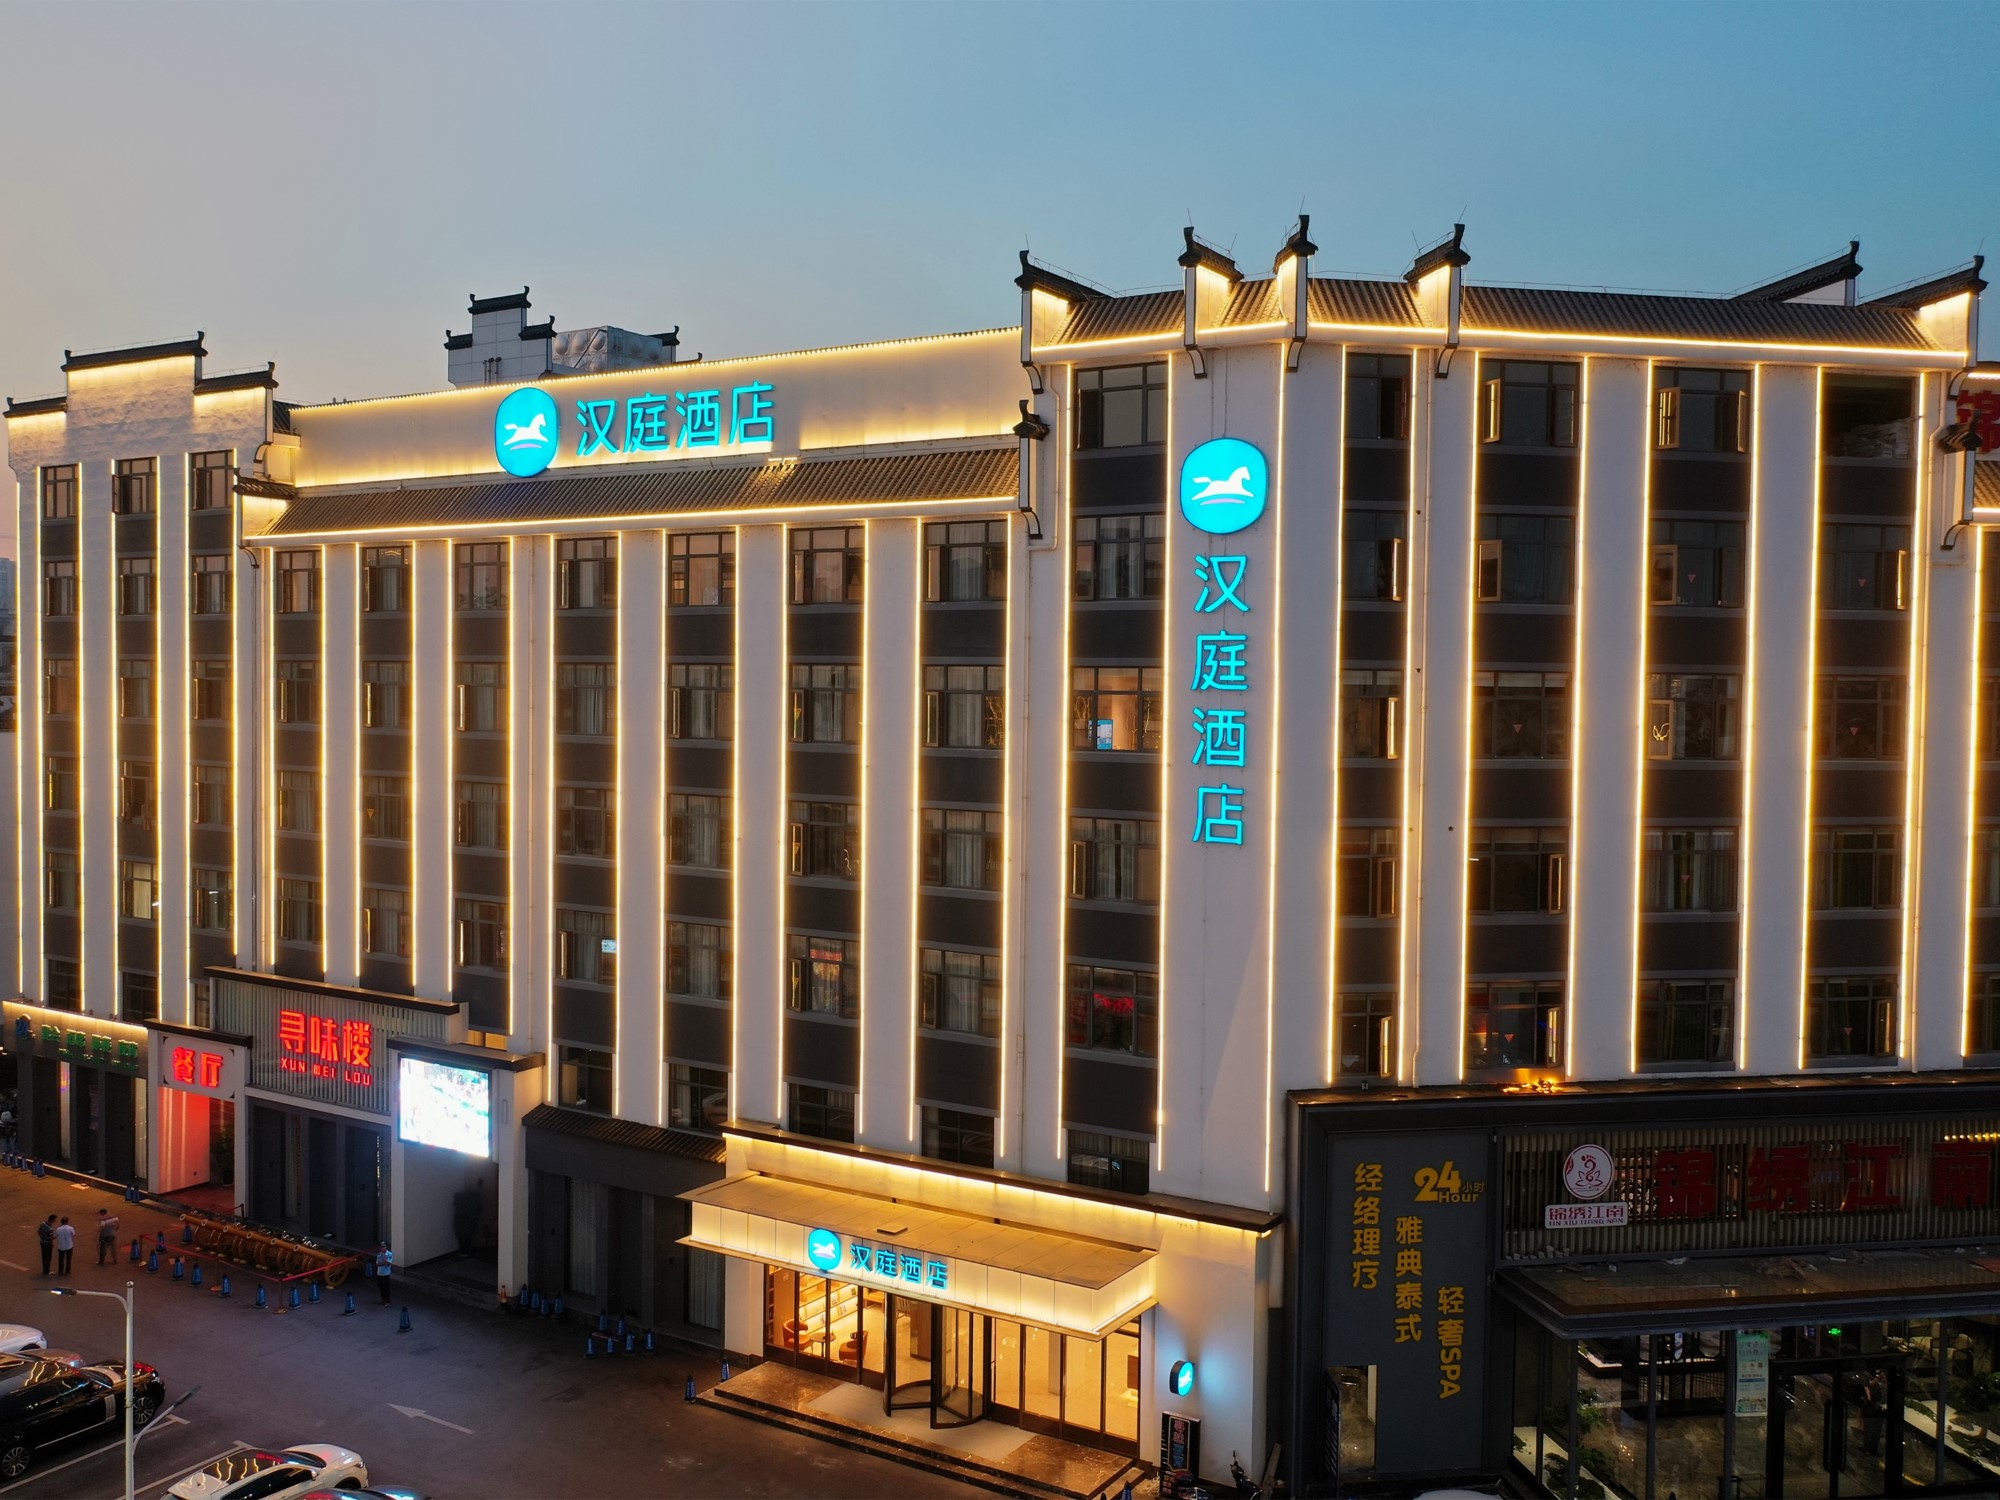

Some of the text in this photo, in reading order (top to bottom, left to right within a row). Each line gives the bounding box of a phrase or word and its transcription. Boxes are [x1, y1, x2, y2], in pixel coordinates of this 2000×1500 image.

[576, 381, 774, 457] 汉庭酒店
[1191, 553, 1251, 846] 汉庭酒店
[172, 1046, 224, 1088] 餐厅
[279, 1008, 373, 1068] 寻味楼
[280, 1056, 372, 1086] XUN WEI LOU
[1413, 1160, 1462, 1202] 24
[1438, 1190, 1480, 1204] Hour
[1652, 1142, 1994, 1219] 锦绣江南
[1352, 1162, 1384, 1290] 经络理疗
[1548, 1204, 1625, 1221] 锦绣江南
[850, 1243, 949, 1290] 汉庭酒店
[1394, 1215, 1424, 1344] 雅典泰式
[1437, 1285, 1466, 1400] 轻奢SPA
